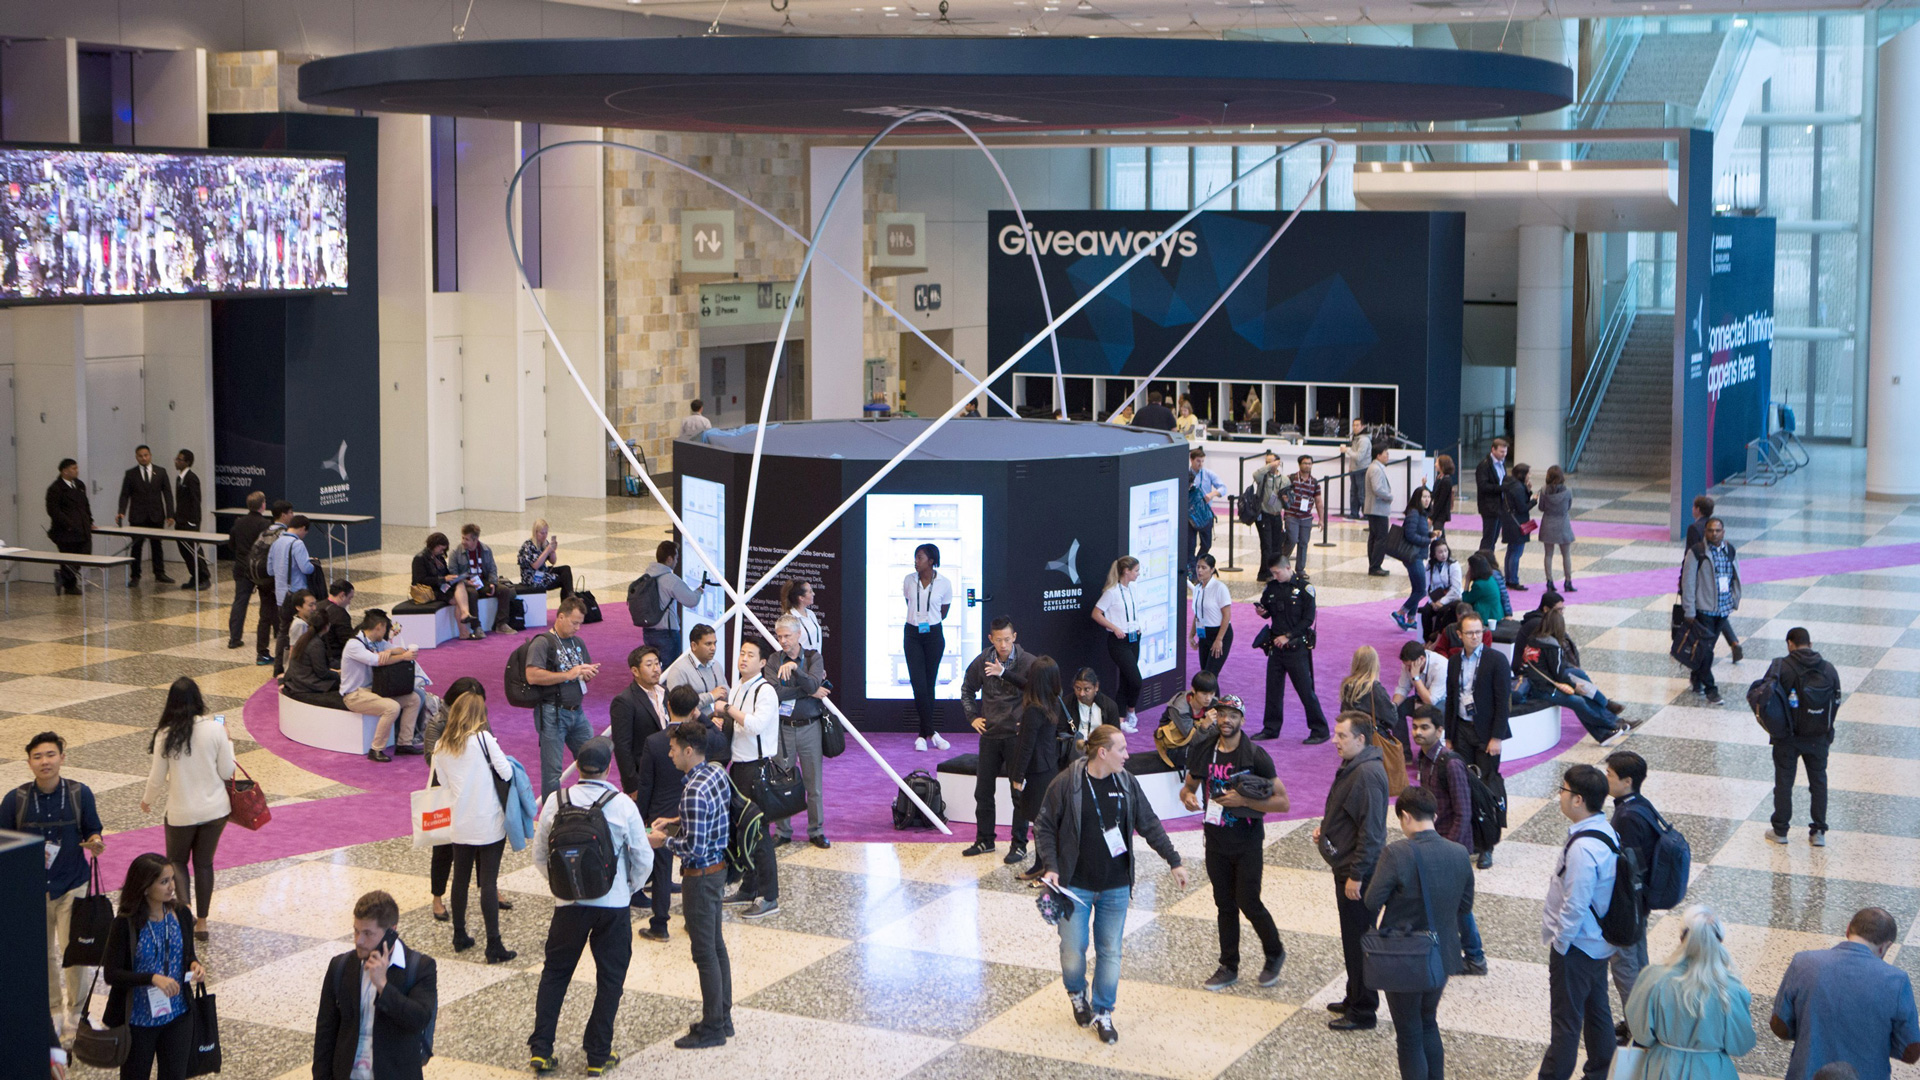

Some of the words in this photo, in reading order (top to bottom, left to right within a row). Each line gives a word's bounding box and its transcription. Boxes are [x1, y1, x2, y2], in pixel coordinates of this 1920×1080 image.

[998, 222, 1198, 267] Giveaways
[1708, 315, 1747, 353] onnected
[1748, 310, 1773, 350] Thinking
[1708, 358, 1737, 401] appens
[319, 483, 350, 495] SAMSUNG
[320, 492, 346, 501] DEVELOPER
[320, 497, 349, 506] CONFERENCE
[1043, 588, 1082, 599] SAMSUNG
[1043, 598, 1077, 606] DEVELOPER
[423, 815, 450, 827] Economi
